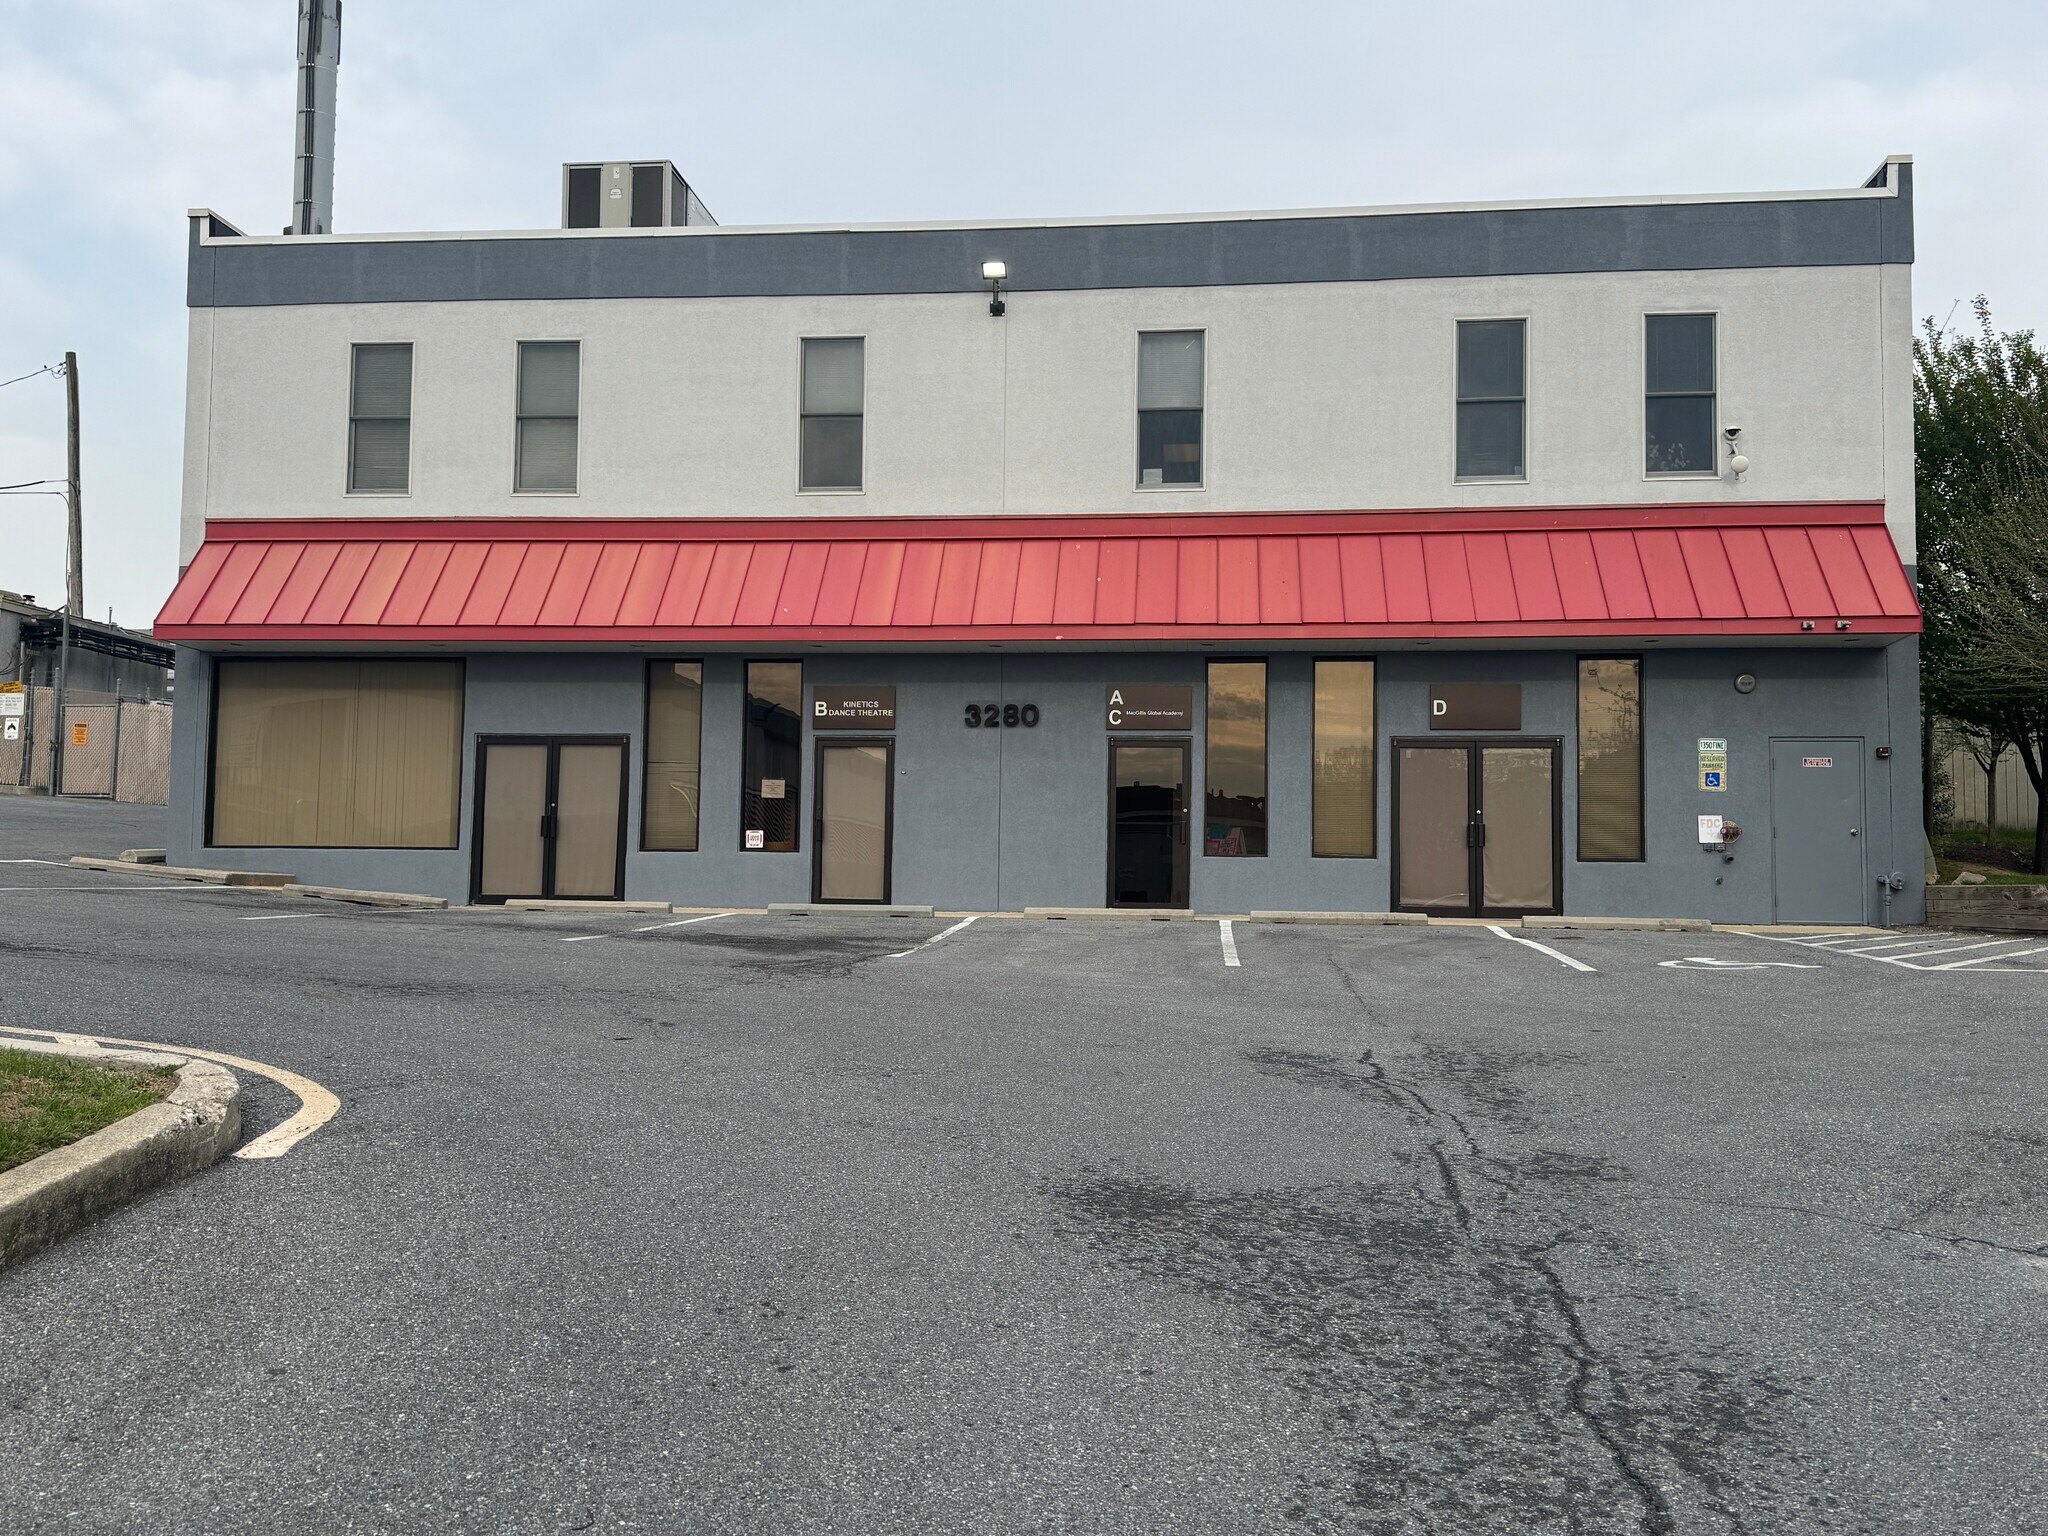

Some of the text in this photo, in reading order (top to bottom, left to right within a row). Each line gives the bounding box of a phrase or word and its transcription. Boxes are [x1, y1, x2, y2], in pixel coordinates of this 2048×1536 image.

[1109, 689, 1124, 705] A
[815, 701, 828, 716] B
[964, 703, 1040, 728] 3280
[1433, 700, 1447, 716] D
[1108, 709, 1122, 725] C
[1713, 741, 1724, 750] FINE
[1700, 818, 1721, 828] FDC
